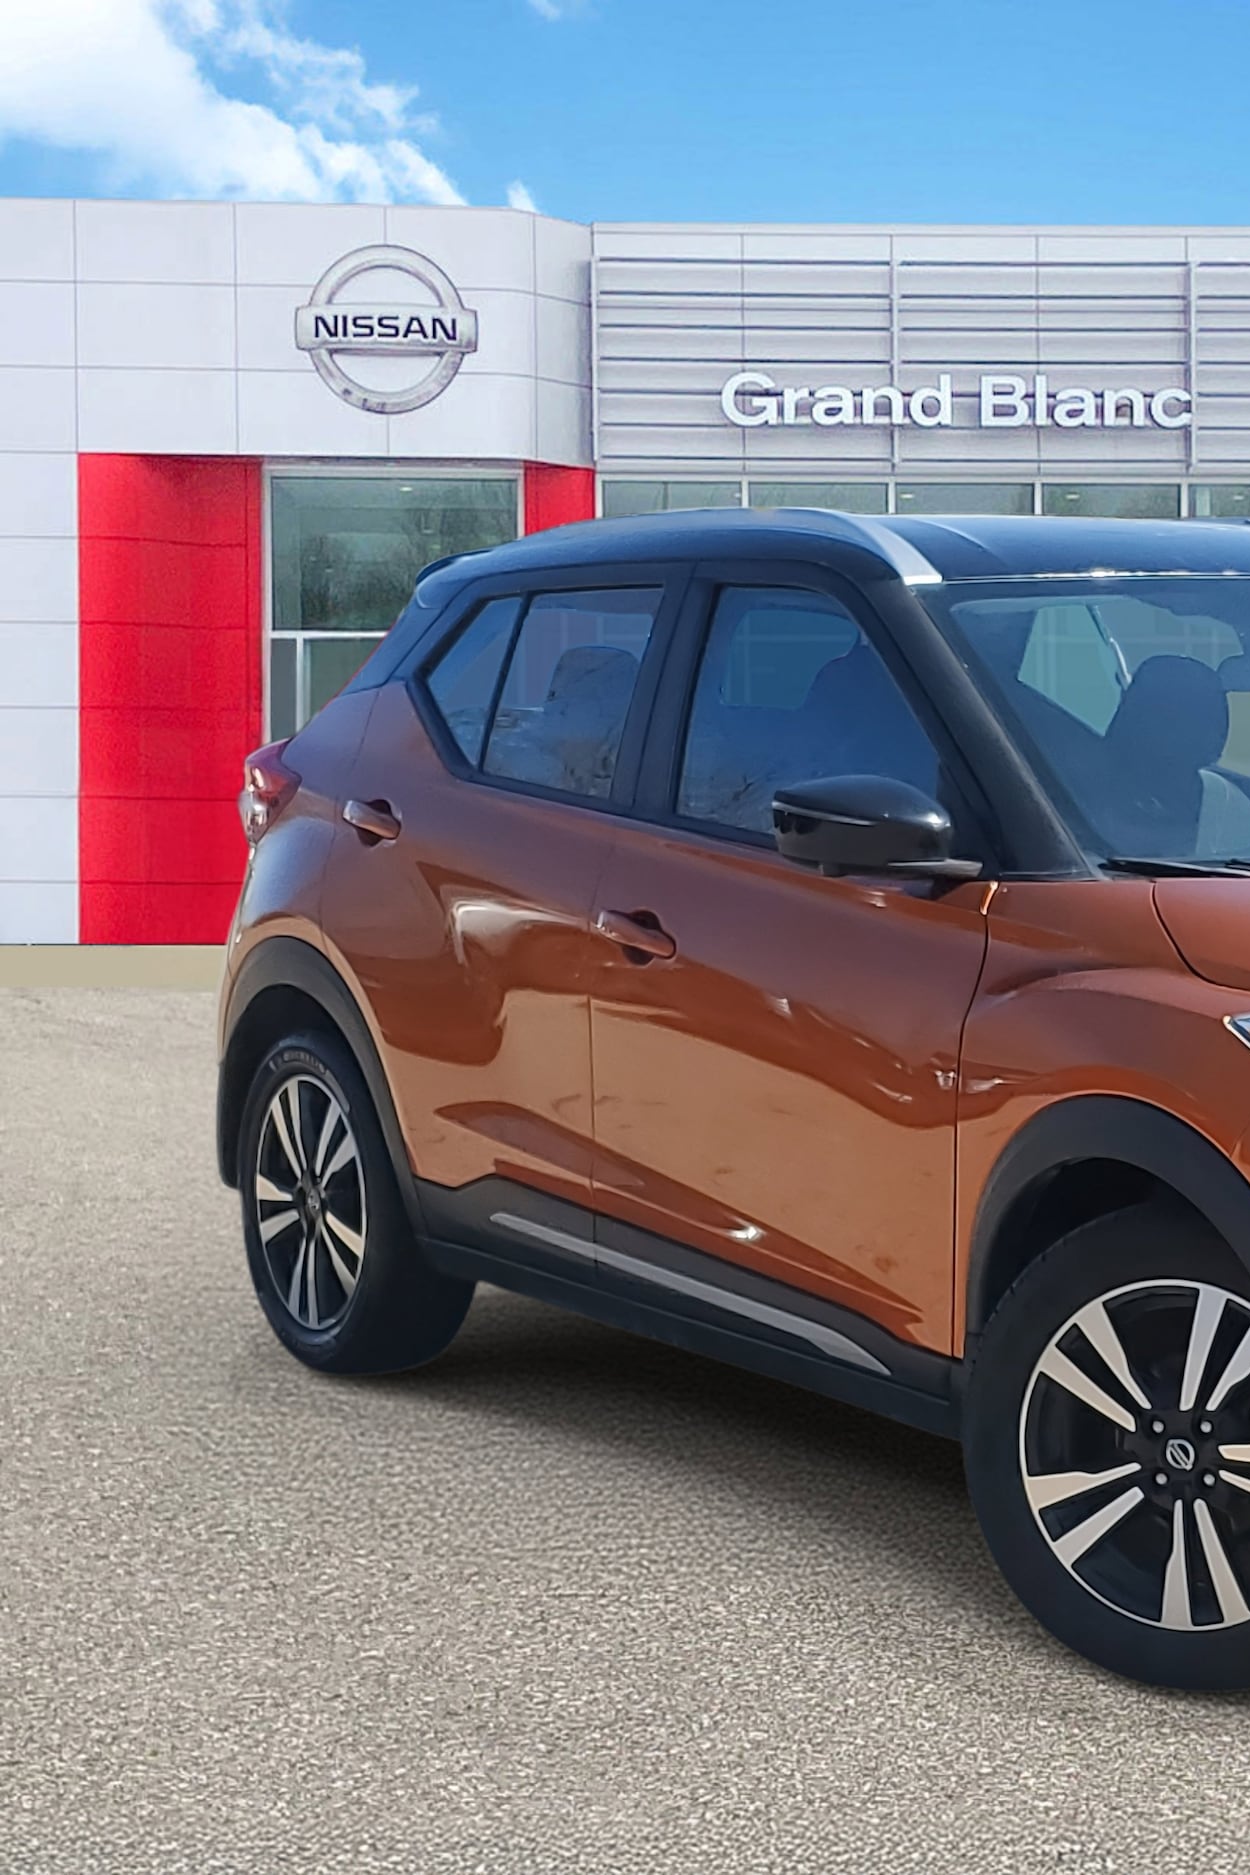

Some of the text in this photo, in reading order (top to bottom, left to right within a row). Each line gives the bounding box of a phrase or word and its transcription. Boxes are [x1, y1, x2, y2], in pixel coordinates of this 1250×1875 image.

[314, 314, 458, 341] NISSAN
[721, 372, 1193, 428] Grand Blanc
